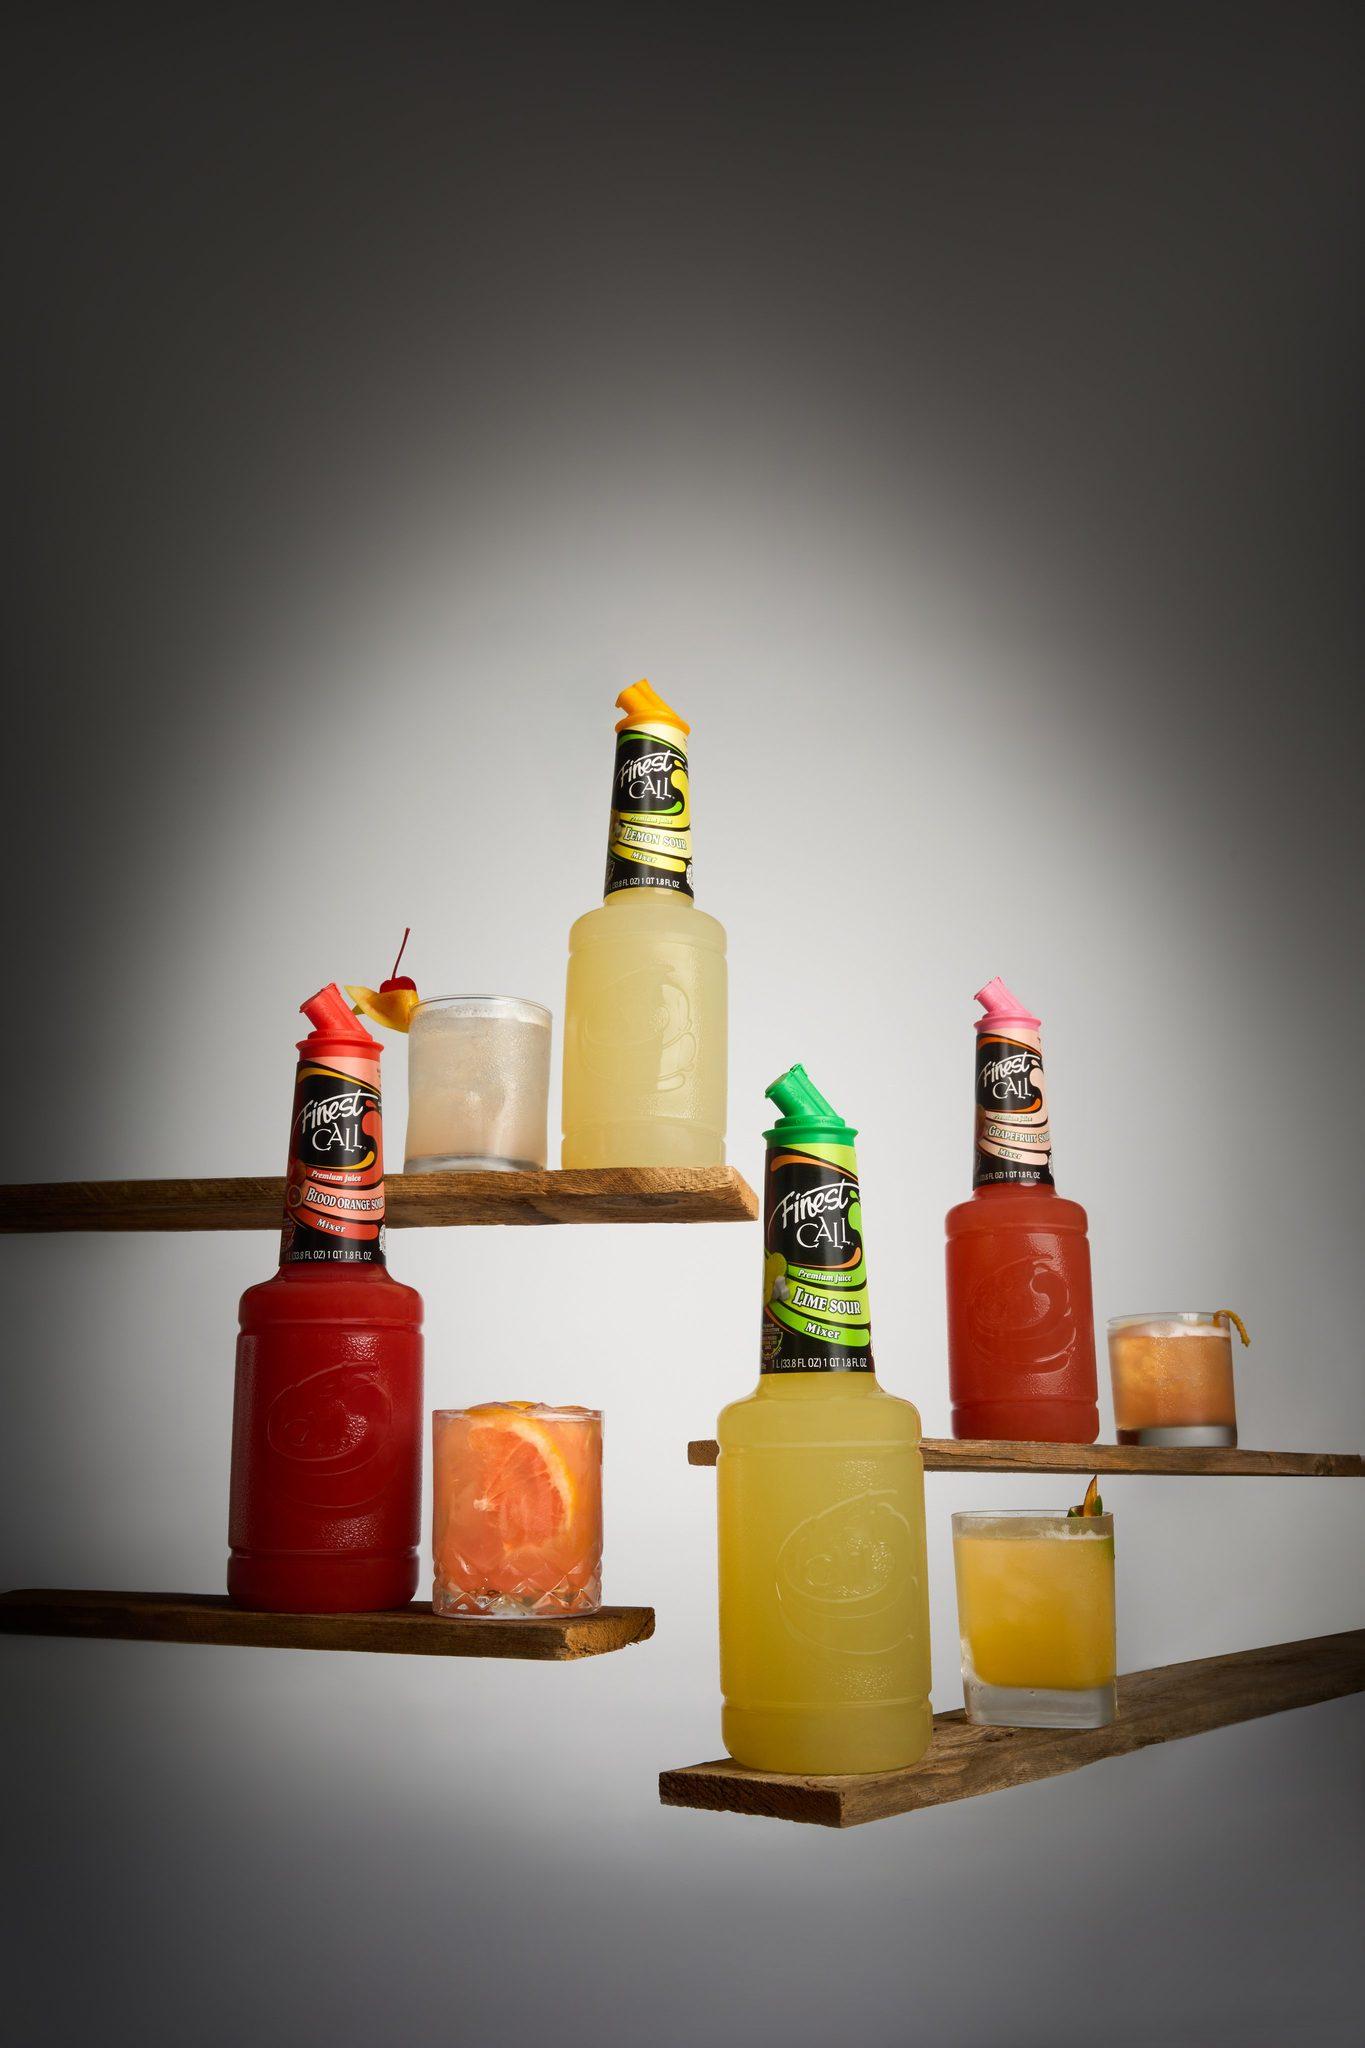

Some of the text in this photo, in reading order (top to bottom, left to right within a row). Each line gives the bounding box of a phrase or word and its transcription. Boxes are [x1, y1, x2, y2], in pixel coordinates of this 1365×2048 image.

[617, 750, 685, 788] Finest
[629, 775, 672, 800] CALL
[623, 826, 688, 850] LEMON SOUR
[645, 876, 655, 885] QT
[655, 877, 665, 885] 1.8
[672, 880, 680, 889] OZ
[982, 1051, 1040, 1088] Finest
[992, 1076, 1032, 1099] CALL
[298, 1089, 378, 1134] Finest
[312, 1122, 362, 1152] CALL
[988, 1125, 1037, 1143] GRAPEFRUIT
[311, 1170, 343, 1181] Premium
[306, 1187, 337, 1207] BLOOD
[337, 1197, 371, 1210] ORANGE
[779, 1179, 859, 1230] Finest
[316, 1218, 346, 1233] Mixer
[796, 1216, 850, 1250] CALL
[332, 1250, 343, 1259] QT
[344, 1250, 354, 1259] 1.8
[355, 1251, 363, 1260] FL
[363, 1251, 372, 1260] OZ
[798, 1269, 834, 1281] Premium
[792, 1286, 861, 1315] LIME SOUR
[805, 1322, 841, 1339] Mixer
[797, 1358, 806, 1368] FL
[807, 1357, 822, 1369] OZ)
[824, 1358, 828, 1368] 1
[829, 1357, 840, 1367] QT
[841, 1358, 852, 1368] 1.8
[852, 1358, 860, 1368] FL
[859, 1358, 868, 1368] OZ
